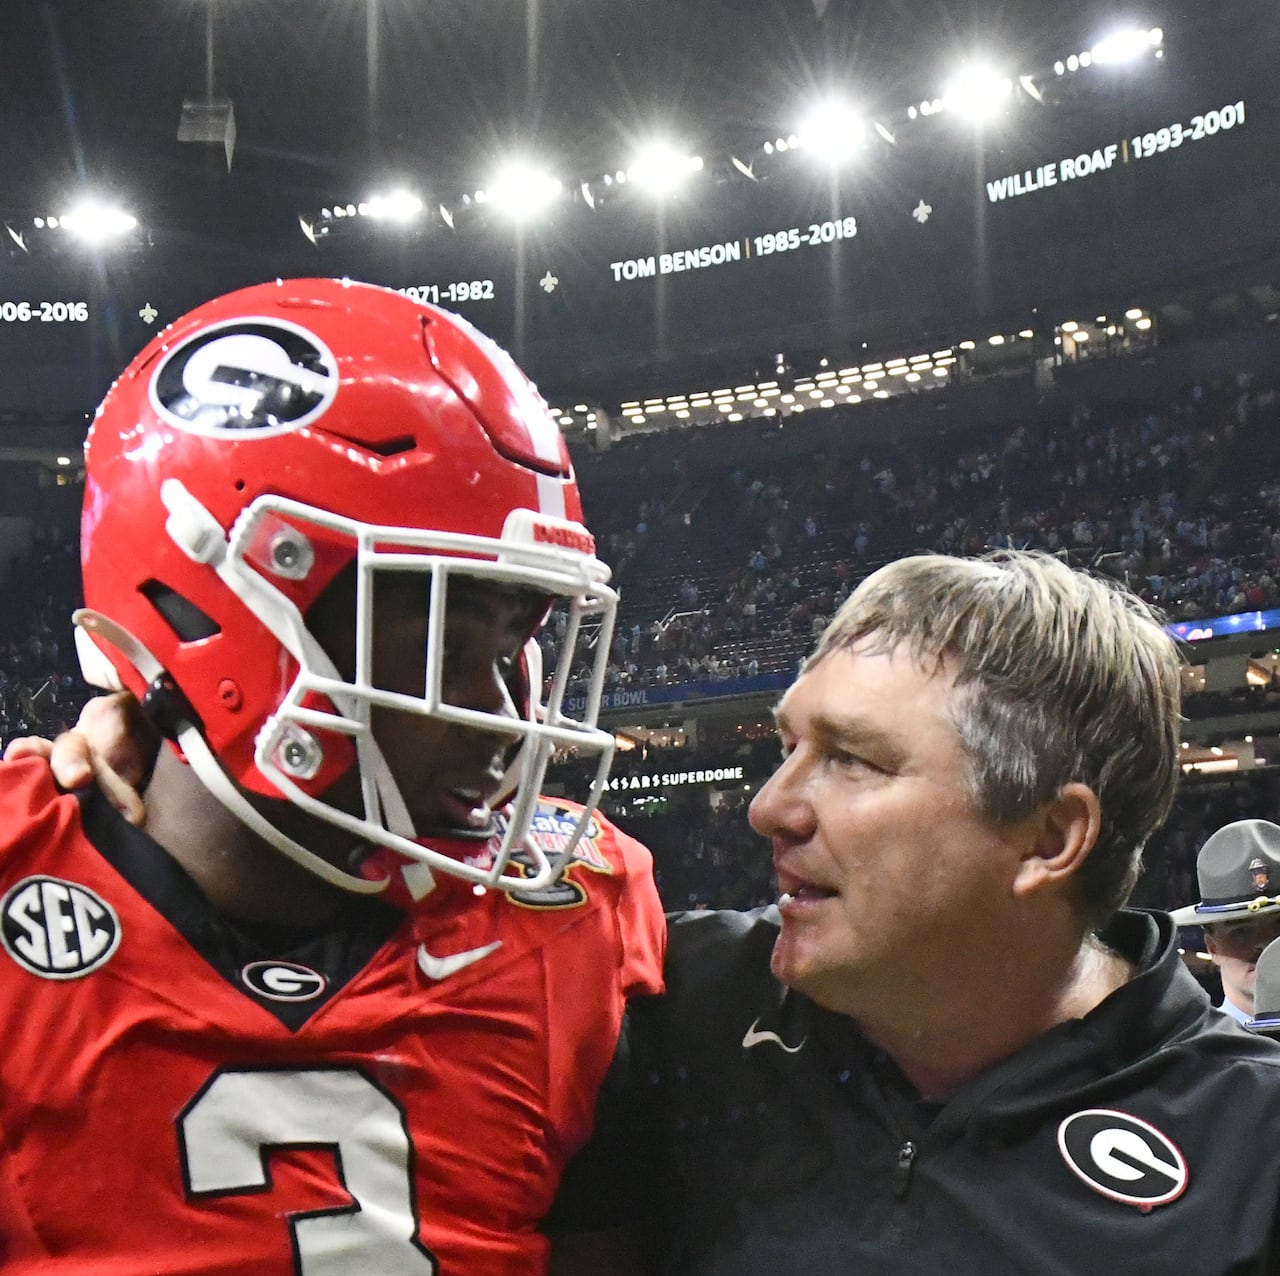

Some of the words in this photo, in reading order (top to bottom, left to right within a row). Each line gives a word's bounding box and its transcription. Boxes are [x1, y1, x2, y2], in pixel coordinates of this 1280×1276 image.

[985, 163, 1058, 202] WILLIE
[1059, 144, 1118, 182] ROAF
[1131, 100, 1245, 159] 1993-2001
[610, 257, 656, 281] TOM
[659, 240, 741, 274] BENSON
[754, 216, 857, 256] 1985-2018
[568, 694, 609, 711] SUR
[661, 766, 744, 786] SUPERDOME
[7, 881, 111, 970] SEC
